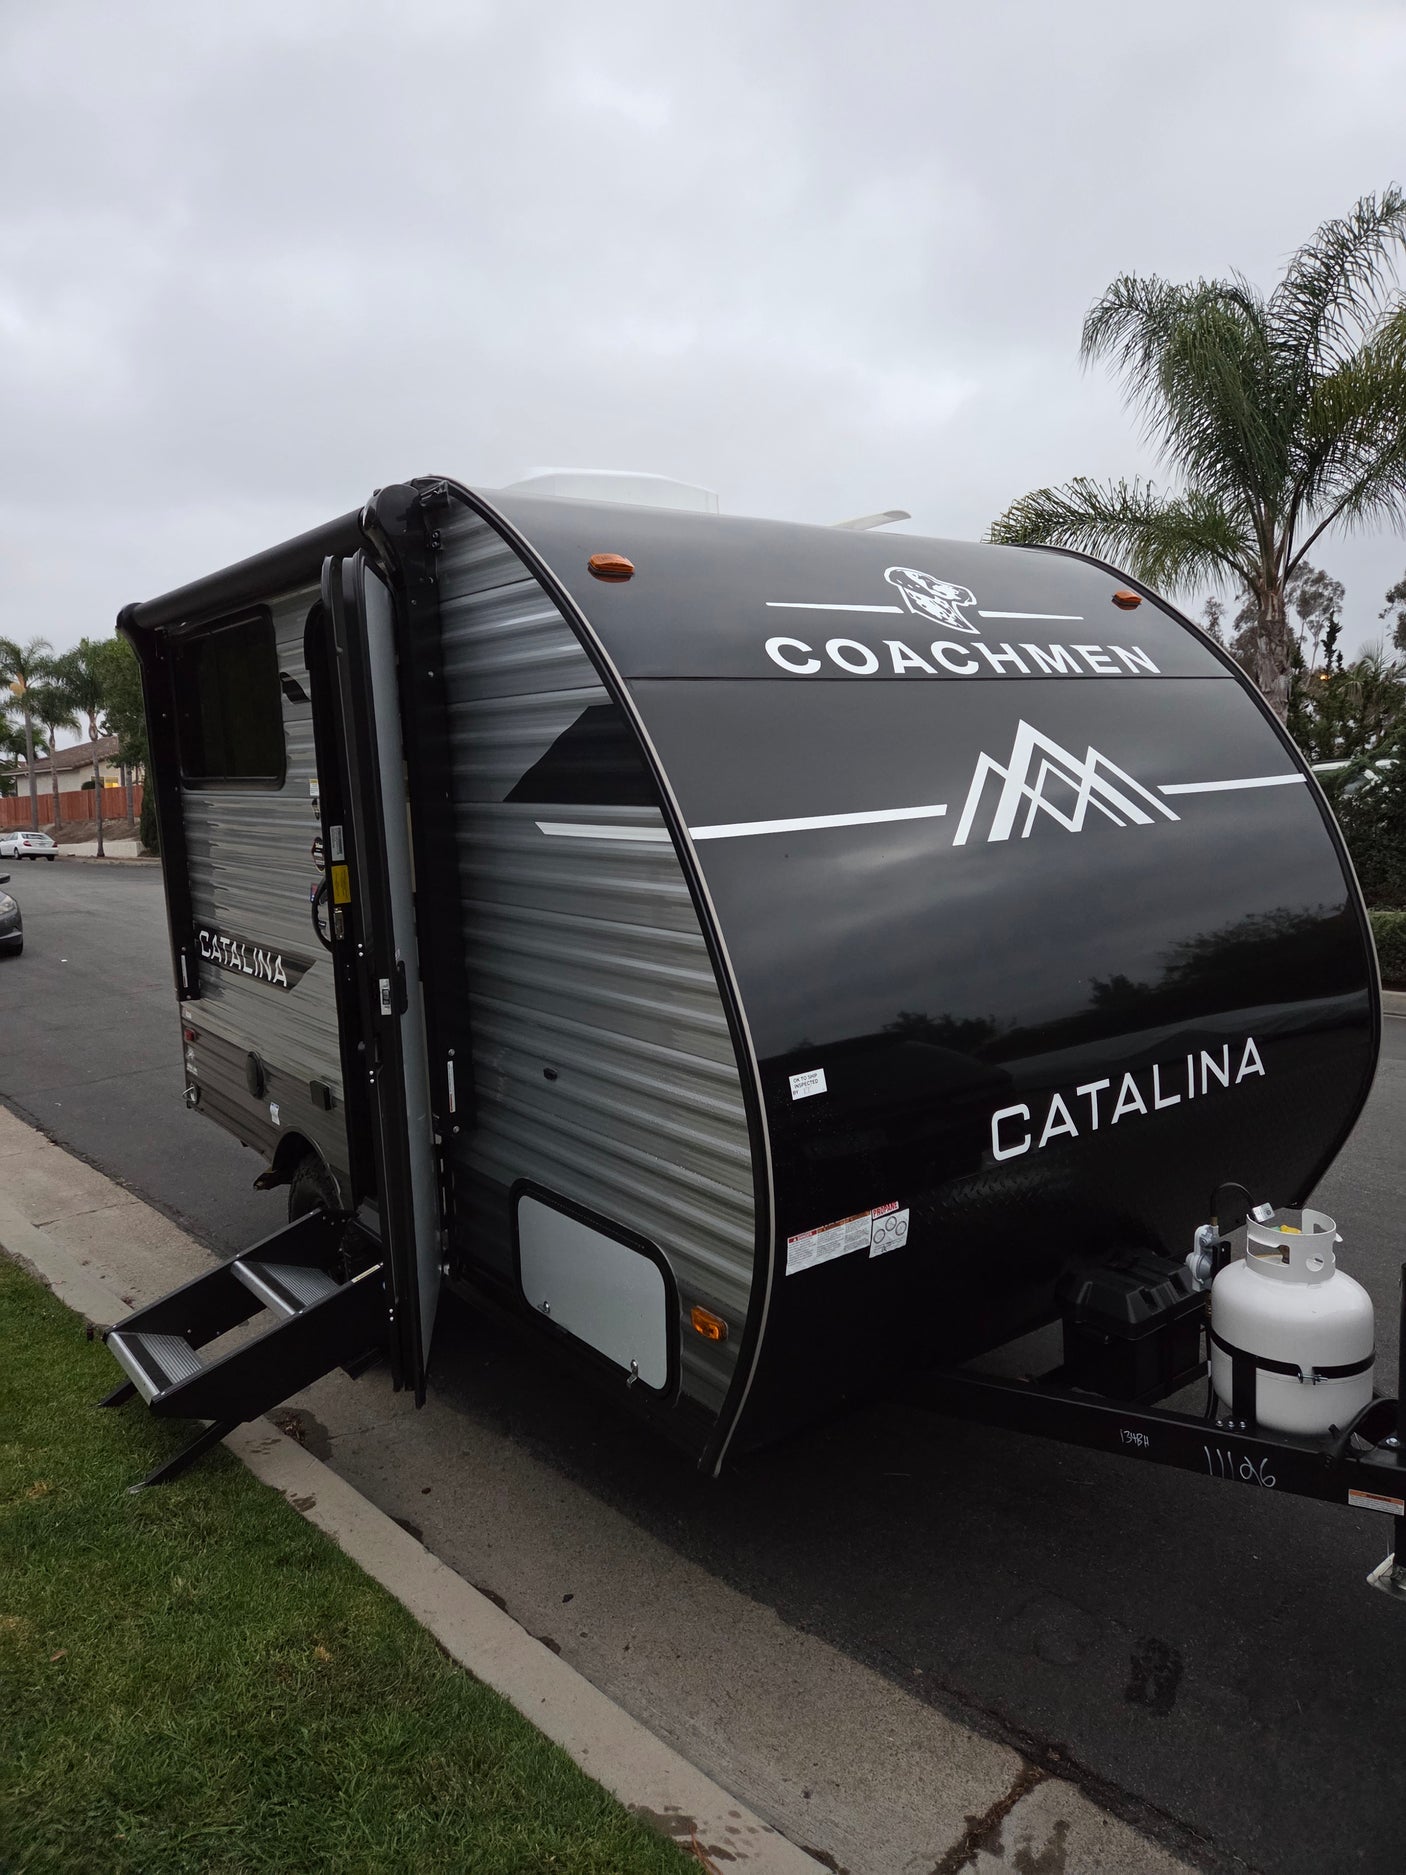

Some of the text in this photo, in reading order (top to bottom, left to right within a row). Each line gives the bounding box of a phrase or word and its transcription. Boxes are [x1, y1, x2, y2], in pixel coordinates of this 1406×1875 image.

[765, 637, 1161, 675] COACHMEN
[199, 930, 287, 987] CATALINA
[991, 1037, 1266, 1161] CATALINA
[873, 1201, 898, 1218] PROPANE
